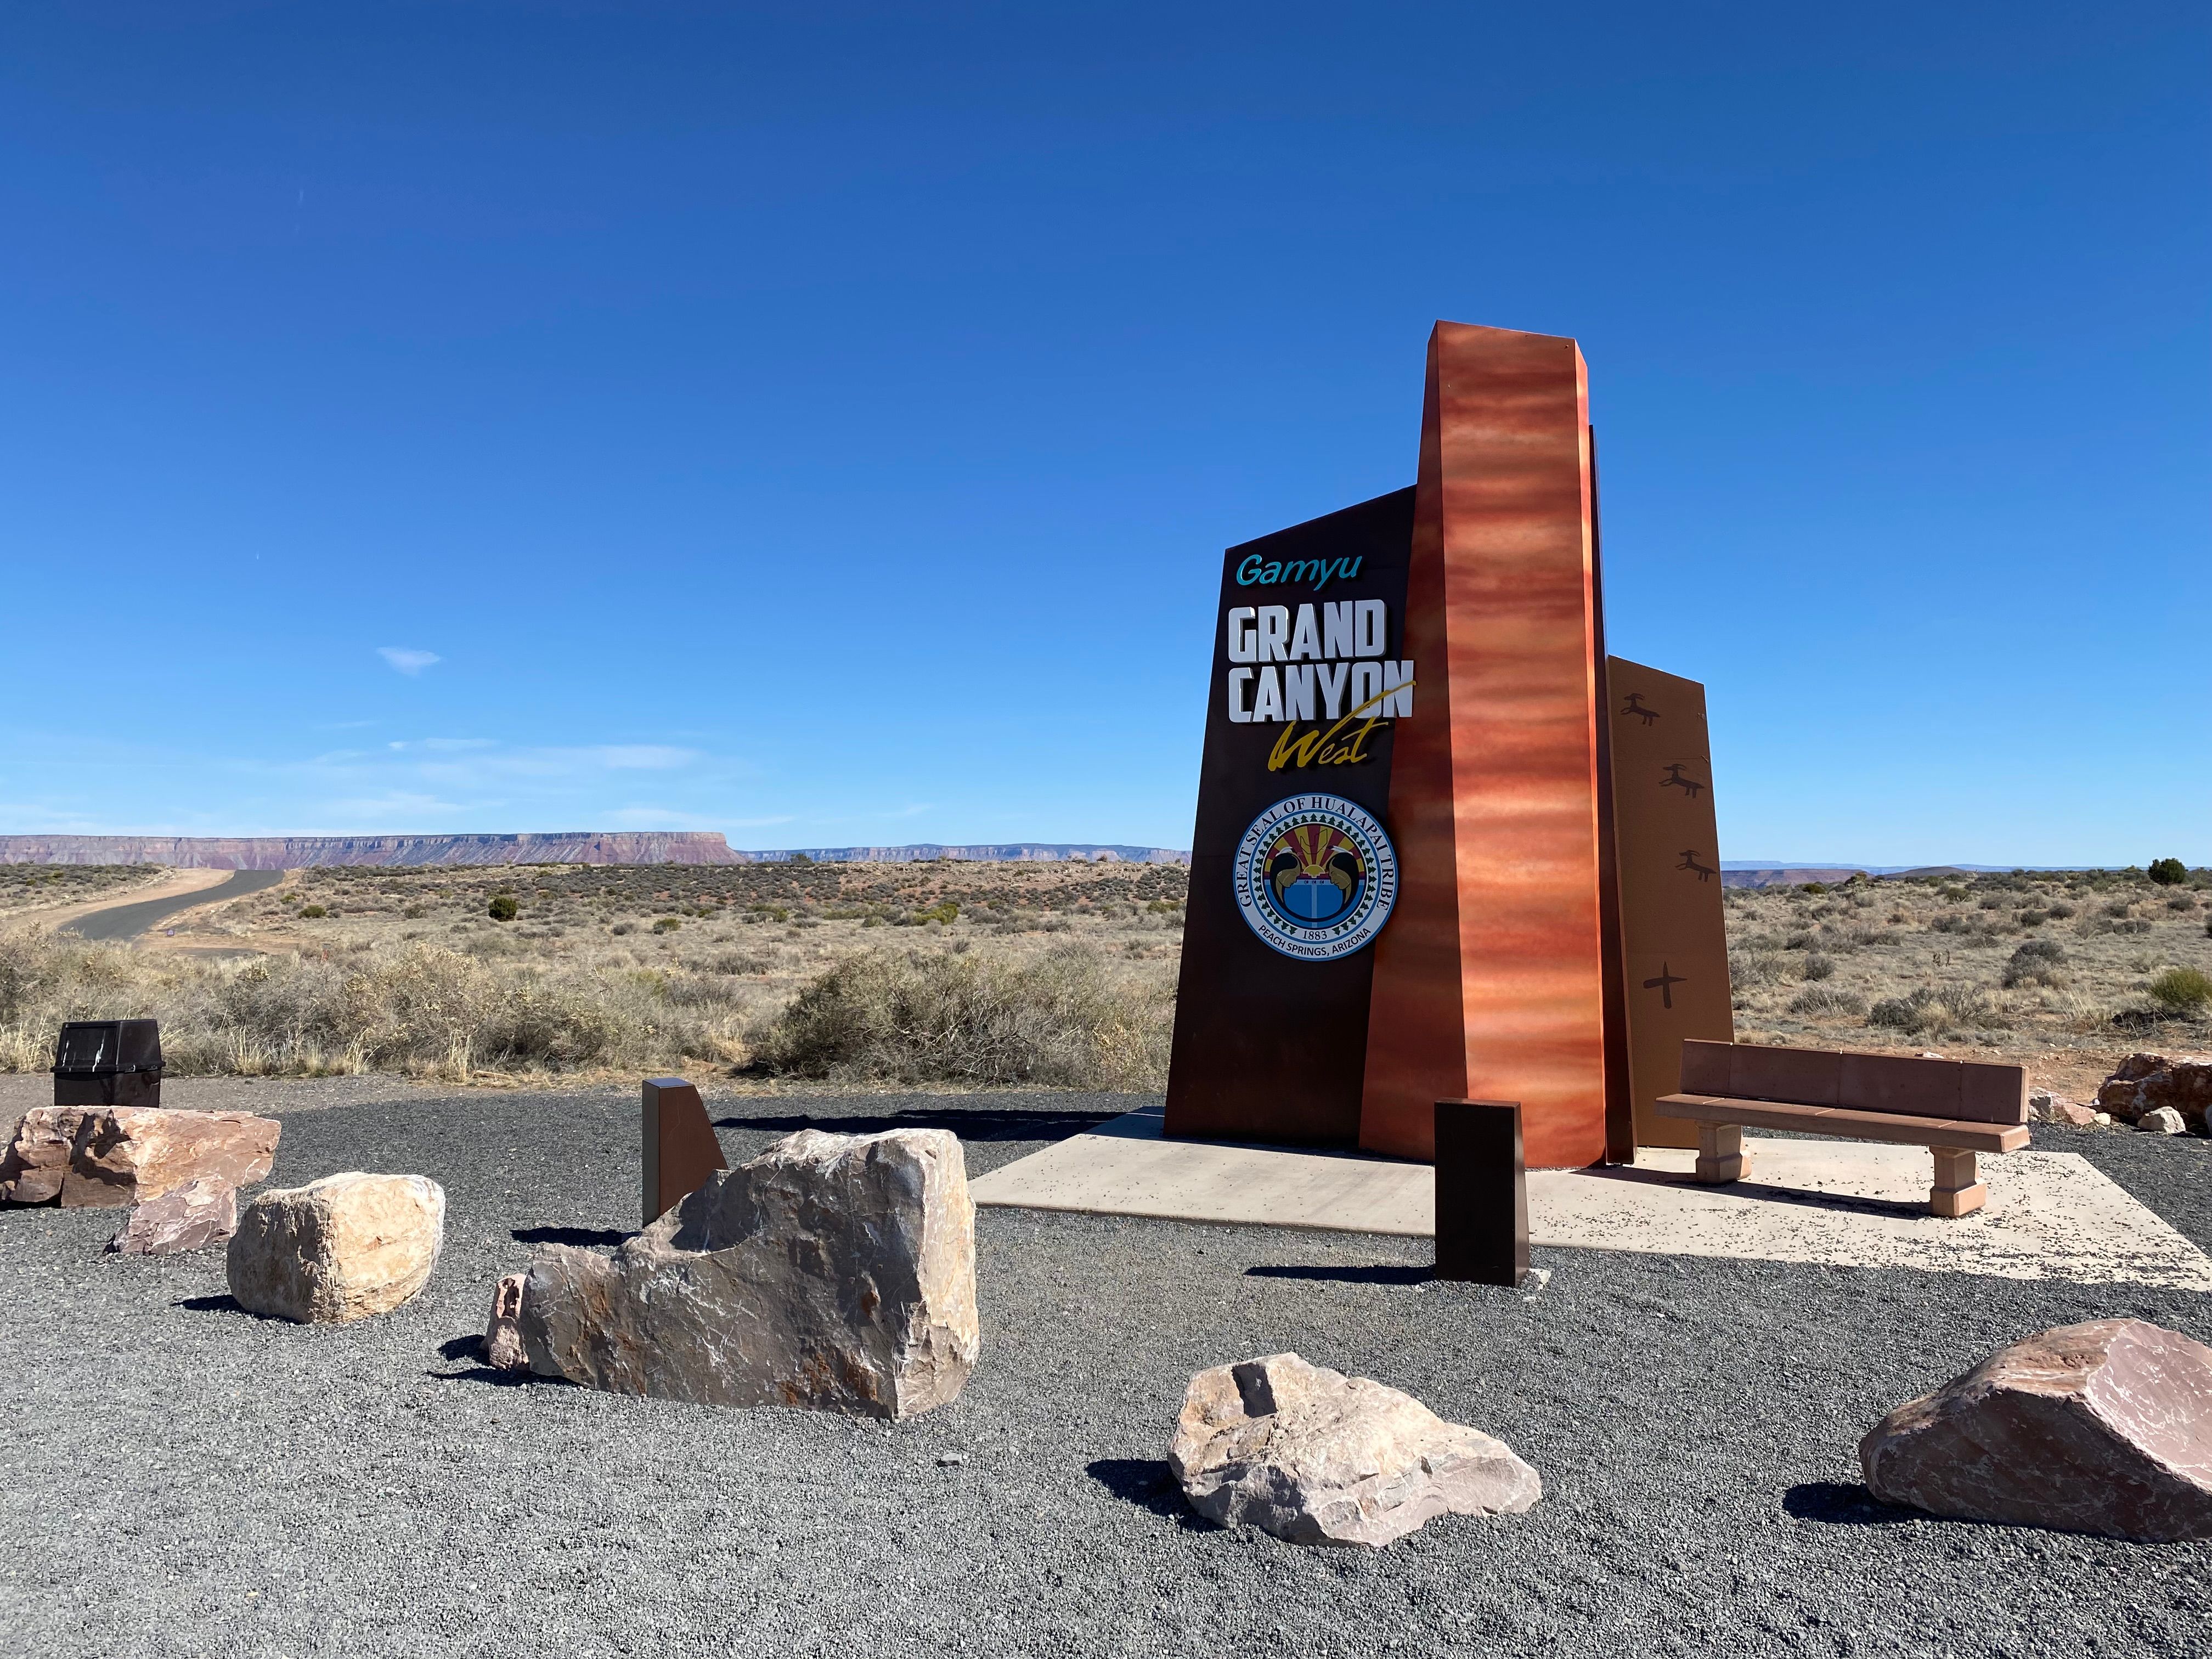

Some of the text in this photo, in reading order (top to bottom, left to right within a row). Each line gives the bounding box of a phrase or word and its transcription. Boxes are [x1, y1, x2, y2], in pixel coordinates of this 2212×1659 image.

[1237, 554, 1362, 591] Gamyu
[1228, 599, 1387, 663] GRAND
[1228, 660, 1414, 723] CANYON
[1268, 681, 1417, 772] West
[1236, 797, 1394, 911] GREAT SEAL OF HUALAPAI TRIBE
[1258, 924, 1372, 957] PEACH SPRINGS, ARIZONA
[1302, 930, 1328, 940] 1883
